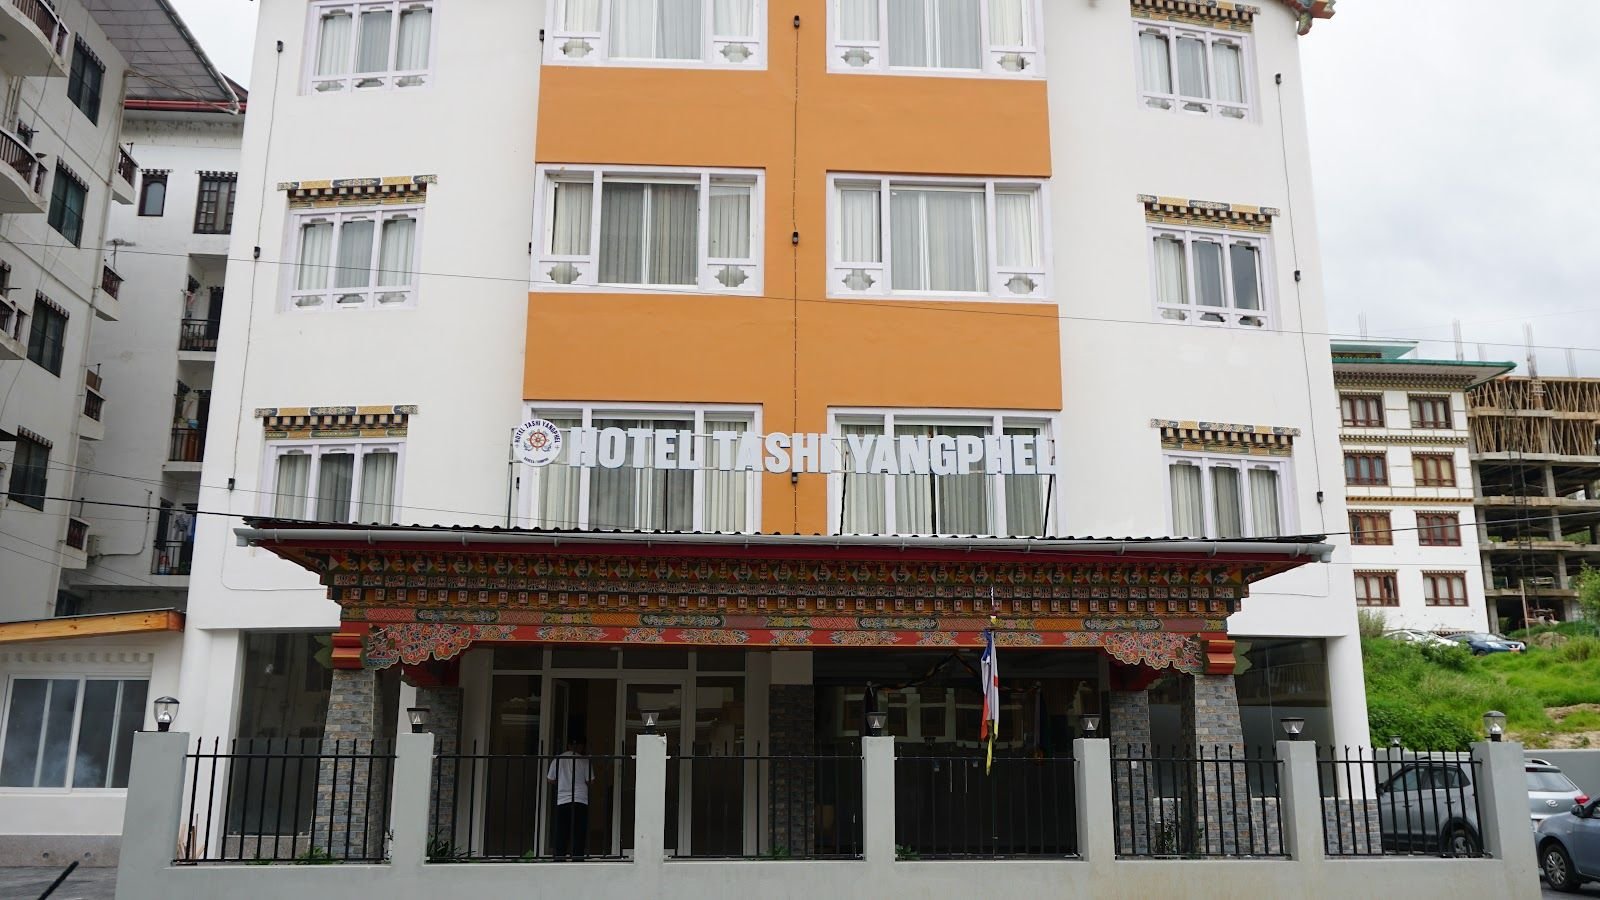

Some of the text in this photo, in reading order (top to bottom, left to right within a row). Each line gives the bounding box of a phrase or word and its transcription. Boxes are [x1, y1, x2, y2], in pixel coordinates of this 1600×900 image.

[514, 420, 561, 443] HOTEL TASHI YANGPHEL
[569, 426, 1056, 475] HOTEL TASHI YANGPHEL
